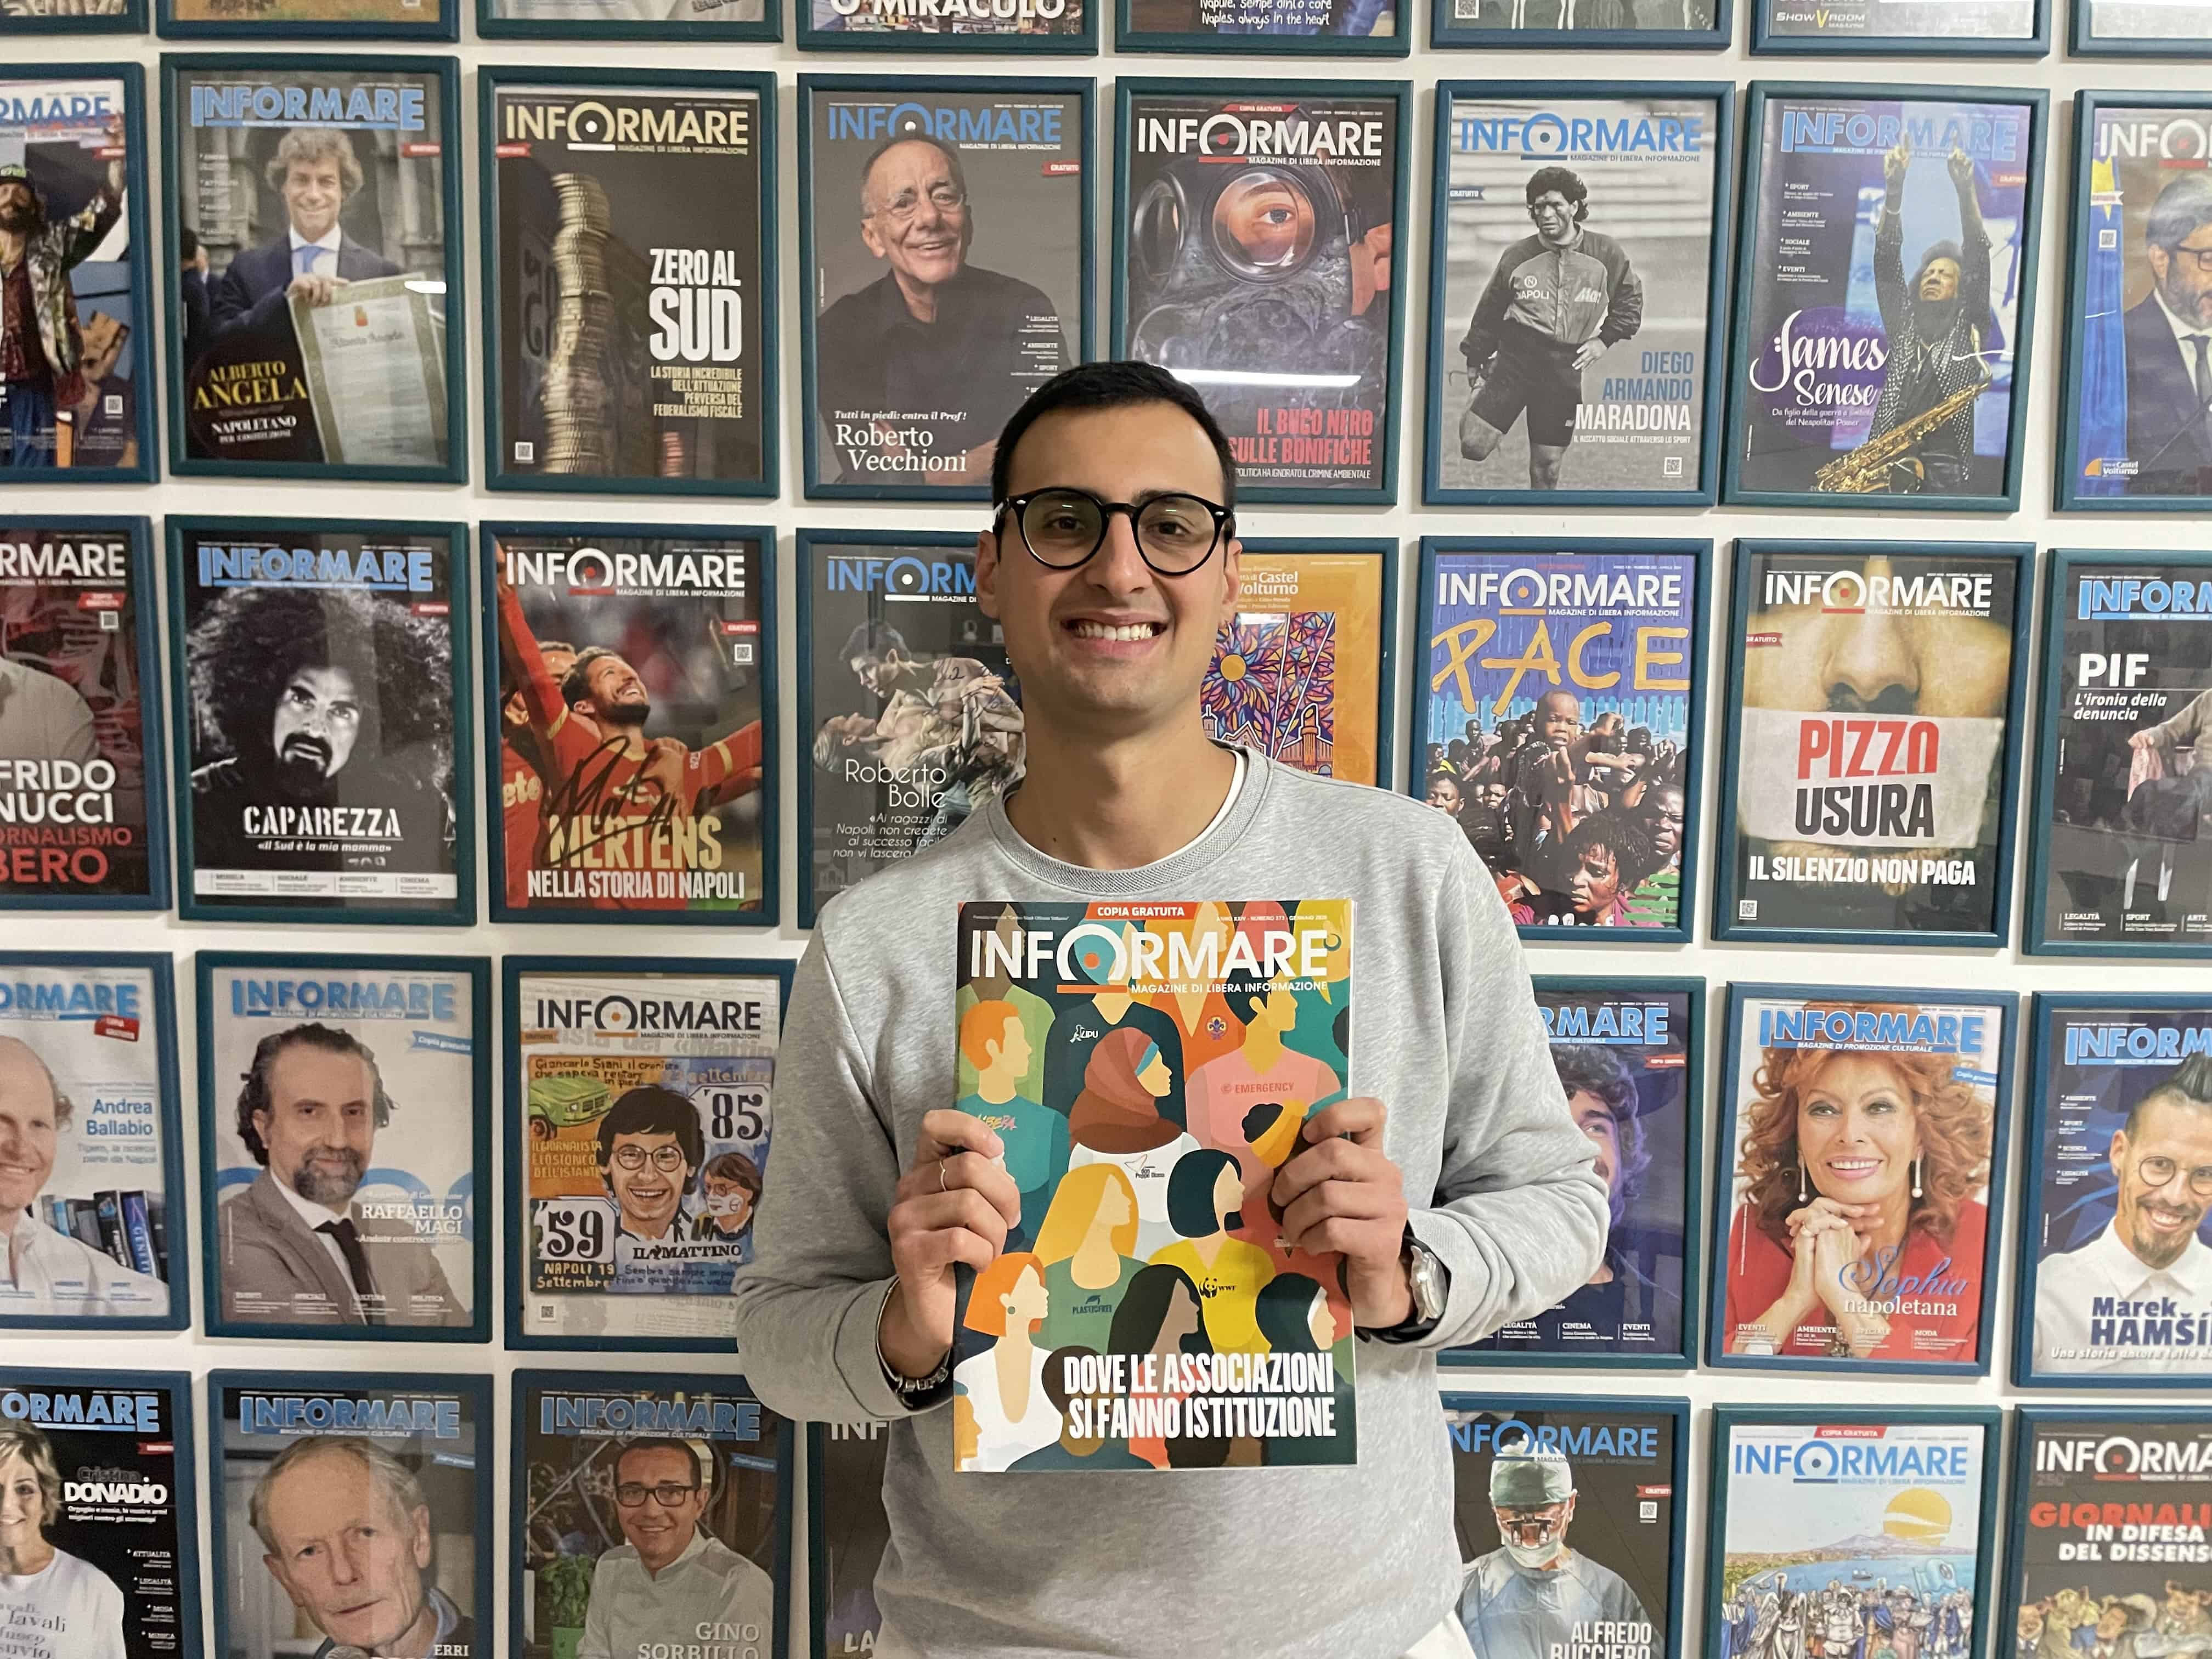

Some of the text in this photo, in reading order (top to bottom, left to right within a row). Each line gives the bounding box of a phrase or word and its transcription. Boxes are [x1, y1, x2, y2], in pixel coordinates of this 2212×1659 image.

[1202, 10, 1234, 27] Naples,
[1238, 10, 1269, 30] always
[1286, 12, 1302, 25] the
[1305, 12, 1330, 25] heart
[191, 86, 425, 130] INFORMARE
[505, 101, 748, 144] INFORMARE
[829, 103, 1062, 142] INFORMARE
[1138, 114, 1383, 156] INFORMARE
[1461, 112, 1703, 151] INFORMARE
[1781, 111, 2019, 162] INFORMARE
[2099, 119, 2212, 159] INFO
[1249, 157, 1287, 165] MAGAZINE
[1450, 189, 1479, 198] GRATUITO
[650, 249, 741, 286] ZERO AL
[649, 286, 742, 362] SUD
[1641, 351, 1694, 374] DIEGO
[1749, 309, 1890, 393] James
[209, 360, 286, 383] ALBERTO
[651, 366, 742, 380] LA STORIA INCREDIBILE
[194, 376, 308, 410] ANGELA
[685, 392, 742, 405] PERVERSA DEL
[1602, 378, 1693, 401] ARMANDO
[1793, 369, 1878, 407] Senese
[654, 403, 742, 419] FEDERALISMO FISCALE
[835, 410, 859, 420] Tutti
[860, 410, 870, 420] in
[872, 410, 900, 422] piedi:
[901, 412, 928, 420] entra
[930, 411, 938, 420] il
[1257, 408, 1373, 436] IL BUCO NERO
[1576, 404, 1691, 431] MARADONA
[211, 415, 297, 435] NAPOLETANO
[835, 422, 934, 447] Roberto
[848, 449, 967, 472] Vecchioni
[1228, 436, 1371, 465] SULLE BONIFICHE
[198, 546, 433, 591] INFORMARE
[506, 548, 745, 588] INFORMARE
[1259, 571, 1299, 583] Castel
[616, 588, 654, 596] MAGAZINE
[665, 589, 689, 597] LIBERA
[691, 589, 745, 597] INFORMAZIONE
[1438, 568, 1681, 607] INFORMARE
[1765, 570, 1993, 608] INFORMARE
[2078, 579, 2212, 619] INFOR
[1624, 609, 1680, 617] INFORMAZIONE
[1431, 619, 1691, 717] PACE
[2078, 653, 2149, 687] PIF
[2074, 693, 2166, 707] L'ironia della
[2074, 707, 2138, 720] denuncia
[845, 759, 947, 785] Roberto
[889, 783, 946, 808] Bolle
[244, 806, 402, 837] CAPAREZZA
[1795, 783, 1935, 837] USURA
[549, 815, 722, 870] MERTENS
[836, 823, 948, 836] Napoli: non credete
[274, 840, 294, 850] Sud
[296, 841, 303, 851] è
[306, 840, 317, 851] la
[319, 842, 339, 851] mia
[1750, 856, 1976, 885] IL SILENZIO NON PAGA
[527, 870, 745, 899] NELLA STORIA DI NAPOLI
[1097, 906, 1185, 917] COPIA GRATUITA
[971, 924, 1328, 981] INFORMARE
[232, 979, 456, 1020] INFORMARE
[1131, 980, 1328, 994] MAGAZINE DI LIBERA INFORMAZIONE
[537, 995, 761, 1031] INFORMARE
[1759, 1009, 1984, 1053] INFORMARE
[1235, 1082, 1295, 1094] EMERGENCY
[93, 1099, 153, 1115] Andrea
[86, 1120, 154, 1136] Ballabio
[362, 1204, 462, 1220] RAFFAELLO
[414, 1220, 462, 1234] MAGI
[633, 1245, 742, 1260] IL MATTINO
[1839, 1246, 1968, 1304] Sophia
[1843, 1296, 1958, 1318] napoletana
[2092, 1296, 2177, 1317] Marek
[1797, 1325, 1837, 1334] AMBIENTE
[1063, 1352, 1334, 1395] DOVE LE ASSOCIAZIONI
[1, 1392, 160, 1432] ORMARE
[240, 1396, 460, 1438] INFORMARE
[540, 1396, 760, 1441] INFORMARE
[1068, 1397, 1336, 1440] SI FANNO ISTITUZIONE
[1735, 1440, 1968, 1476] INFORMARE
[2086, 1523, 2205, 1543] IN DIFESA
[2058, 1542, 2212, 1562] DEL DISSENS
[695, 1621, 760, 1642] GINO
[1571, 1622, 1652, 1644] ALFREDO
